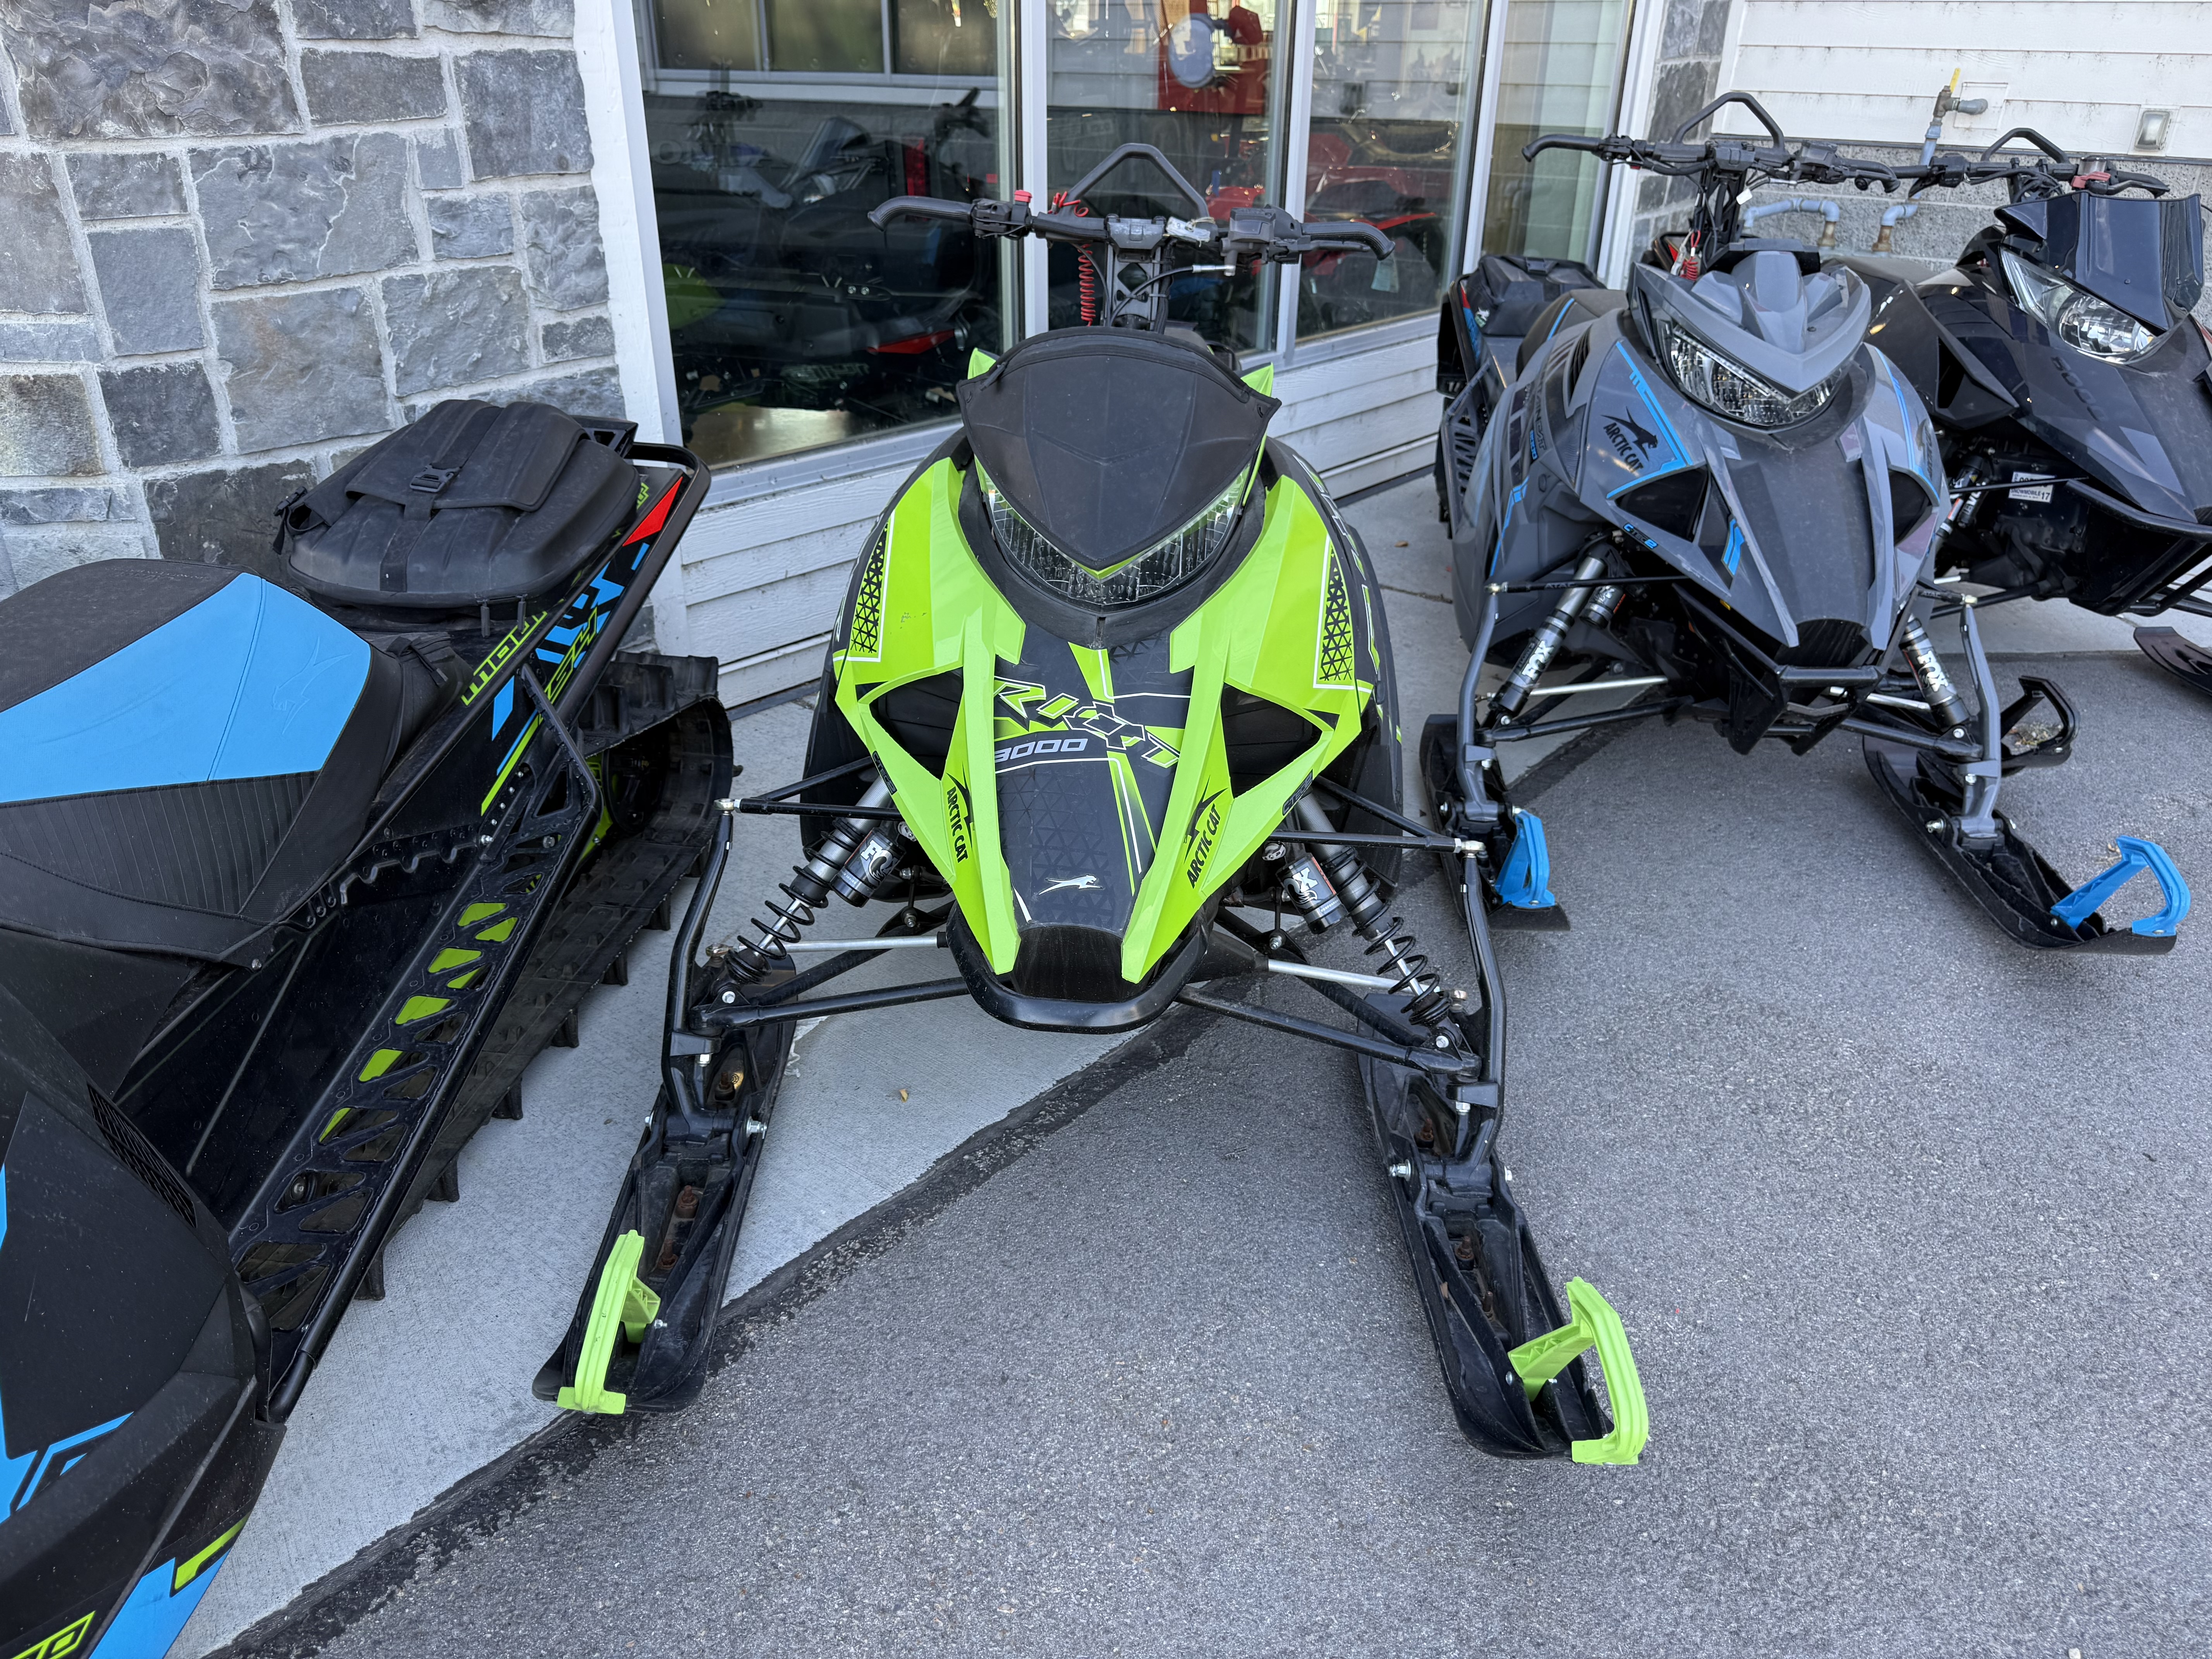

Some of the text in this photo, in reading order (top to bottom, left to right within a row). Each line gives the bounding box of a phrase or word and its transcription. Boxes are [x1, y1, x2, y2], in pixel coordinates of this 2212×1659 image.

[1603, 422, 1644, 472] ARCTIC CAT
[2042, 491, 2051, 500] 17
[1522, 640, 1554, 681] FOX
[1917, 650, 1948, 692] FOX
[947, 786, 969, 863] ARCTIC CAT
[1187, 803, 1221, 889] ARCTIC CAT
